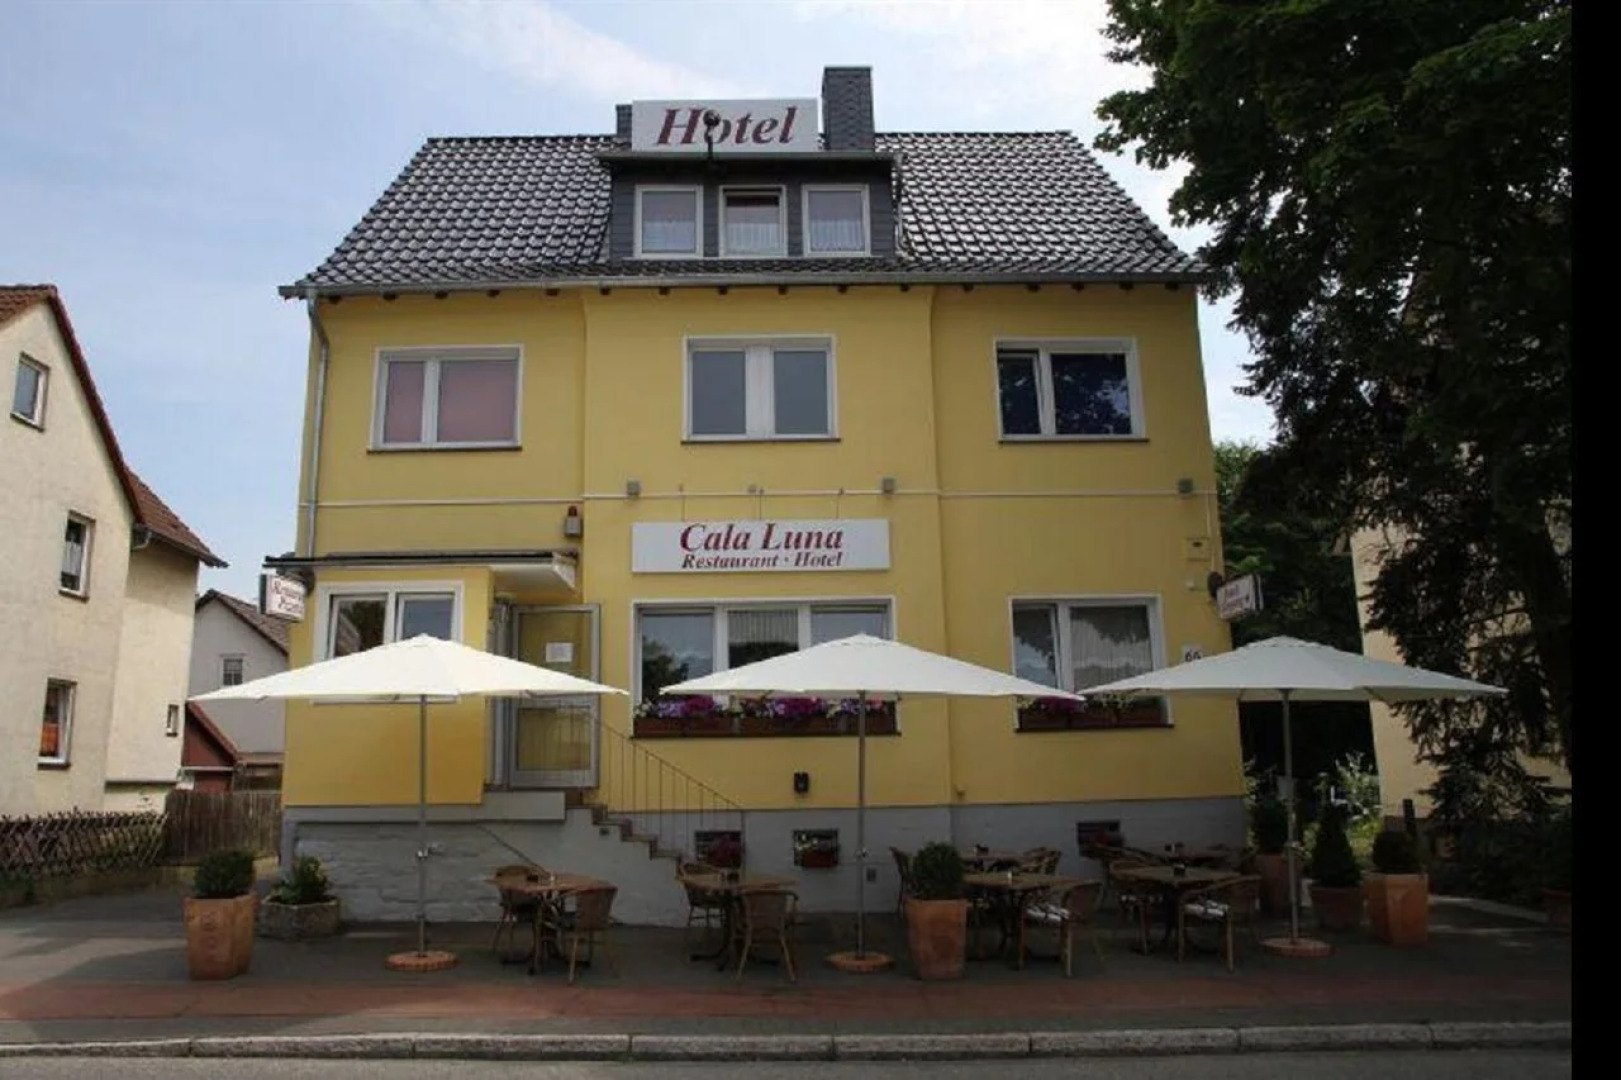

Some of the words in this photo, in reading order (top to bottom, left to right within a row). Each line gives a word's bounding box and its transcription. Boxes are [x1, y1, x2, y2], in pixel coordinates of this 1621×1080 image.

[656, 105, 799, 145] Hotel
[680, 523, 752, 552] Cala
[760, 522, 844, 550] Luna
[681, 553, 780, 569] Restaurant
[794, 551, 843, 567] Hotel
